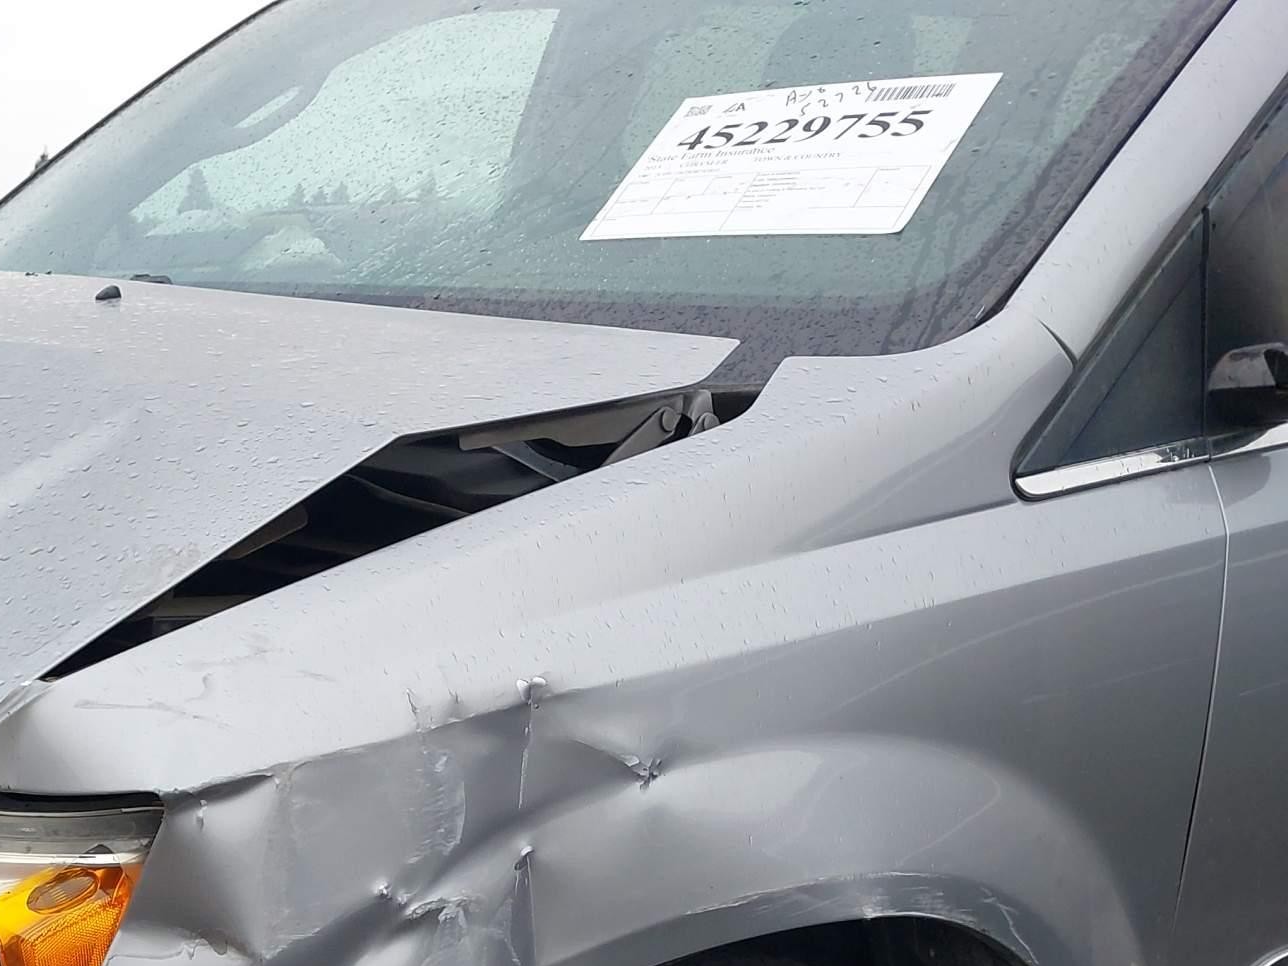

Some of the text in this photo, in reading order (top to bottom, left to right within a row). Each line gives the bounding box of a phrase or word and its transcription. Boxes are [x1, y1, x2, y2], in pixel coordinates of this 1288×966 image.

[677, 110, 934, 151] 45229755
[648, 146, 777, 163] State Farm Insurance
